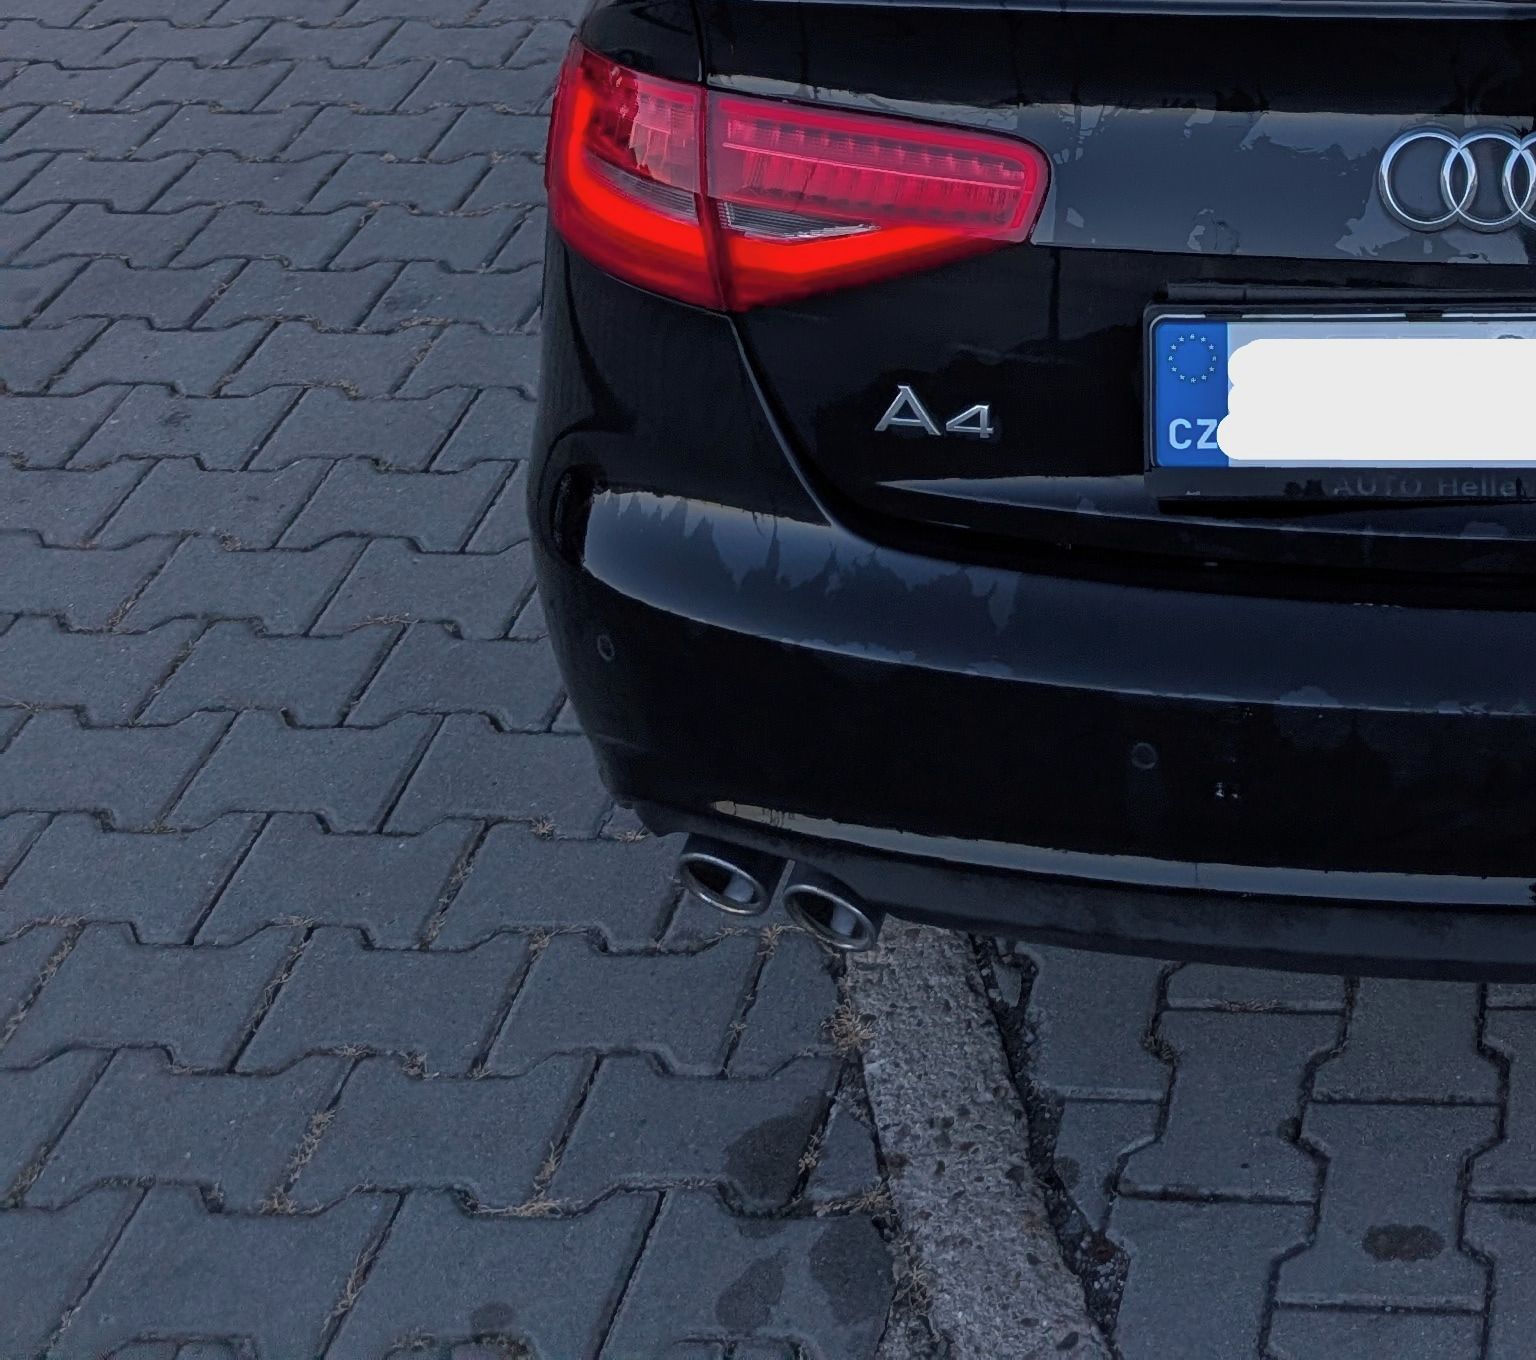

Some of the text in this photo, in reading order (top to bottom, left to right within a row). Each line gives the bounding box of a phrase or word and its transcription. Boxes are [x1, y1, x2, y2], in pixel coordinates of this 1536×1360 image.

[874, 384, 994, 439] A4
[1168, 418, 1219, 450] CZ
[1333, 474, 1422, 497] AUTO
